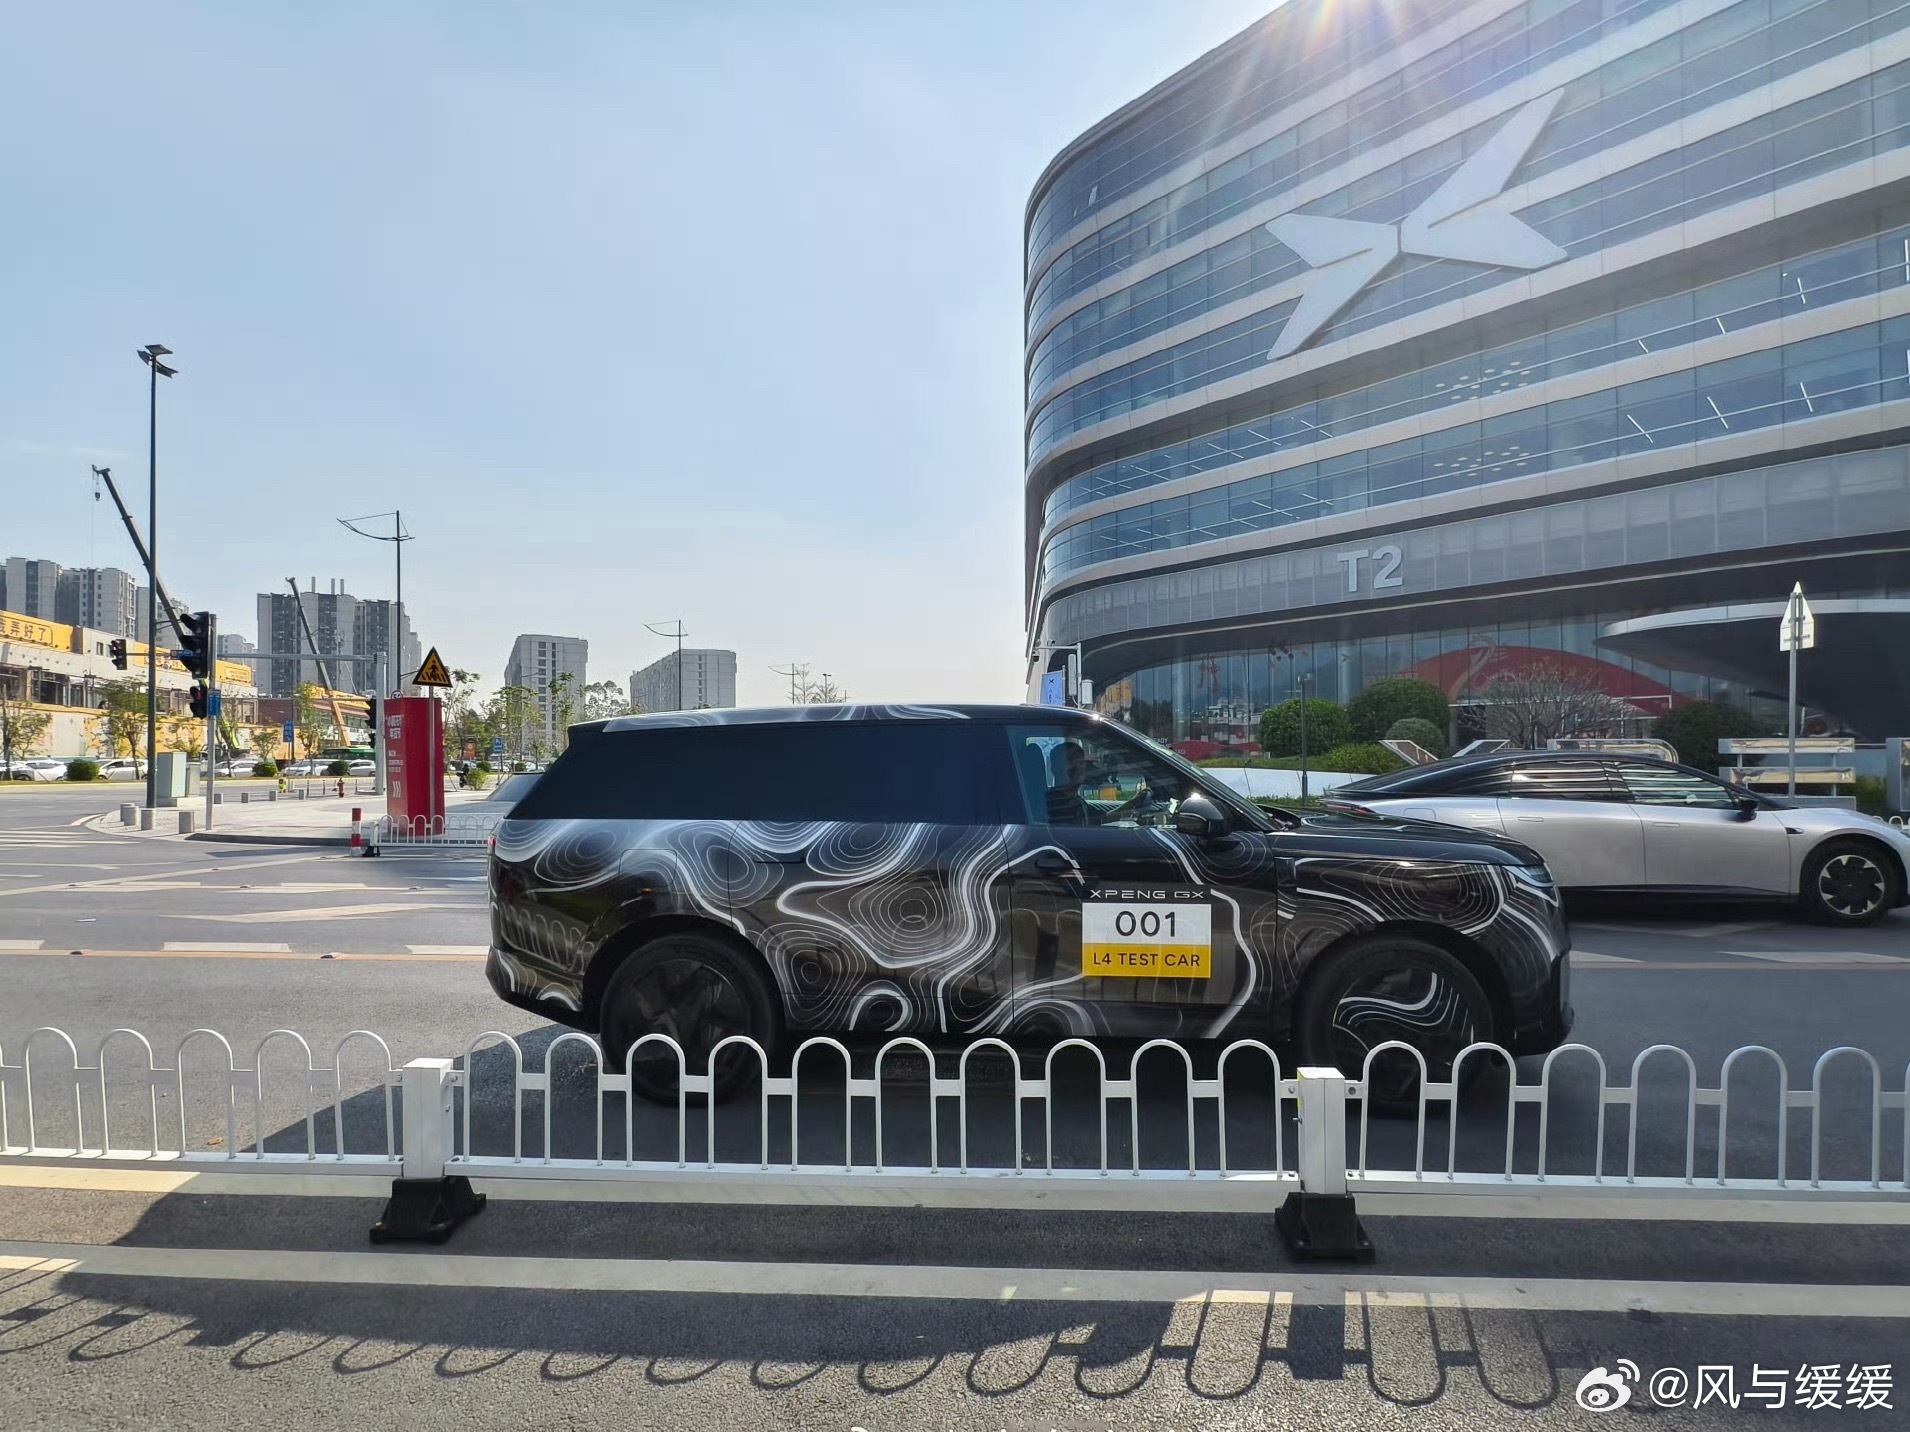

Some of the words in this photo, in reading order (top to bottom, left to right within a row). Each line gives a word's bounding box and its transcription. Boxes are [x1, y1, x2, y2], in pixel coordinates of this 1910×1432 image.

[1337, 545, 1403, 593] T2
[1090, 889, 1166, 899] XPENG
[1174, 891, 1204, 899] GX
[1115, 910, 1176, 938] 001
[1093, 952, 1112, 965] L4
[1118, 953, 1158, 966] TEST
[1164, 954, 1200, 967] CAR
